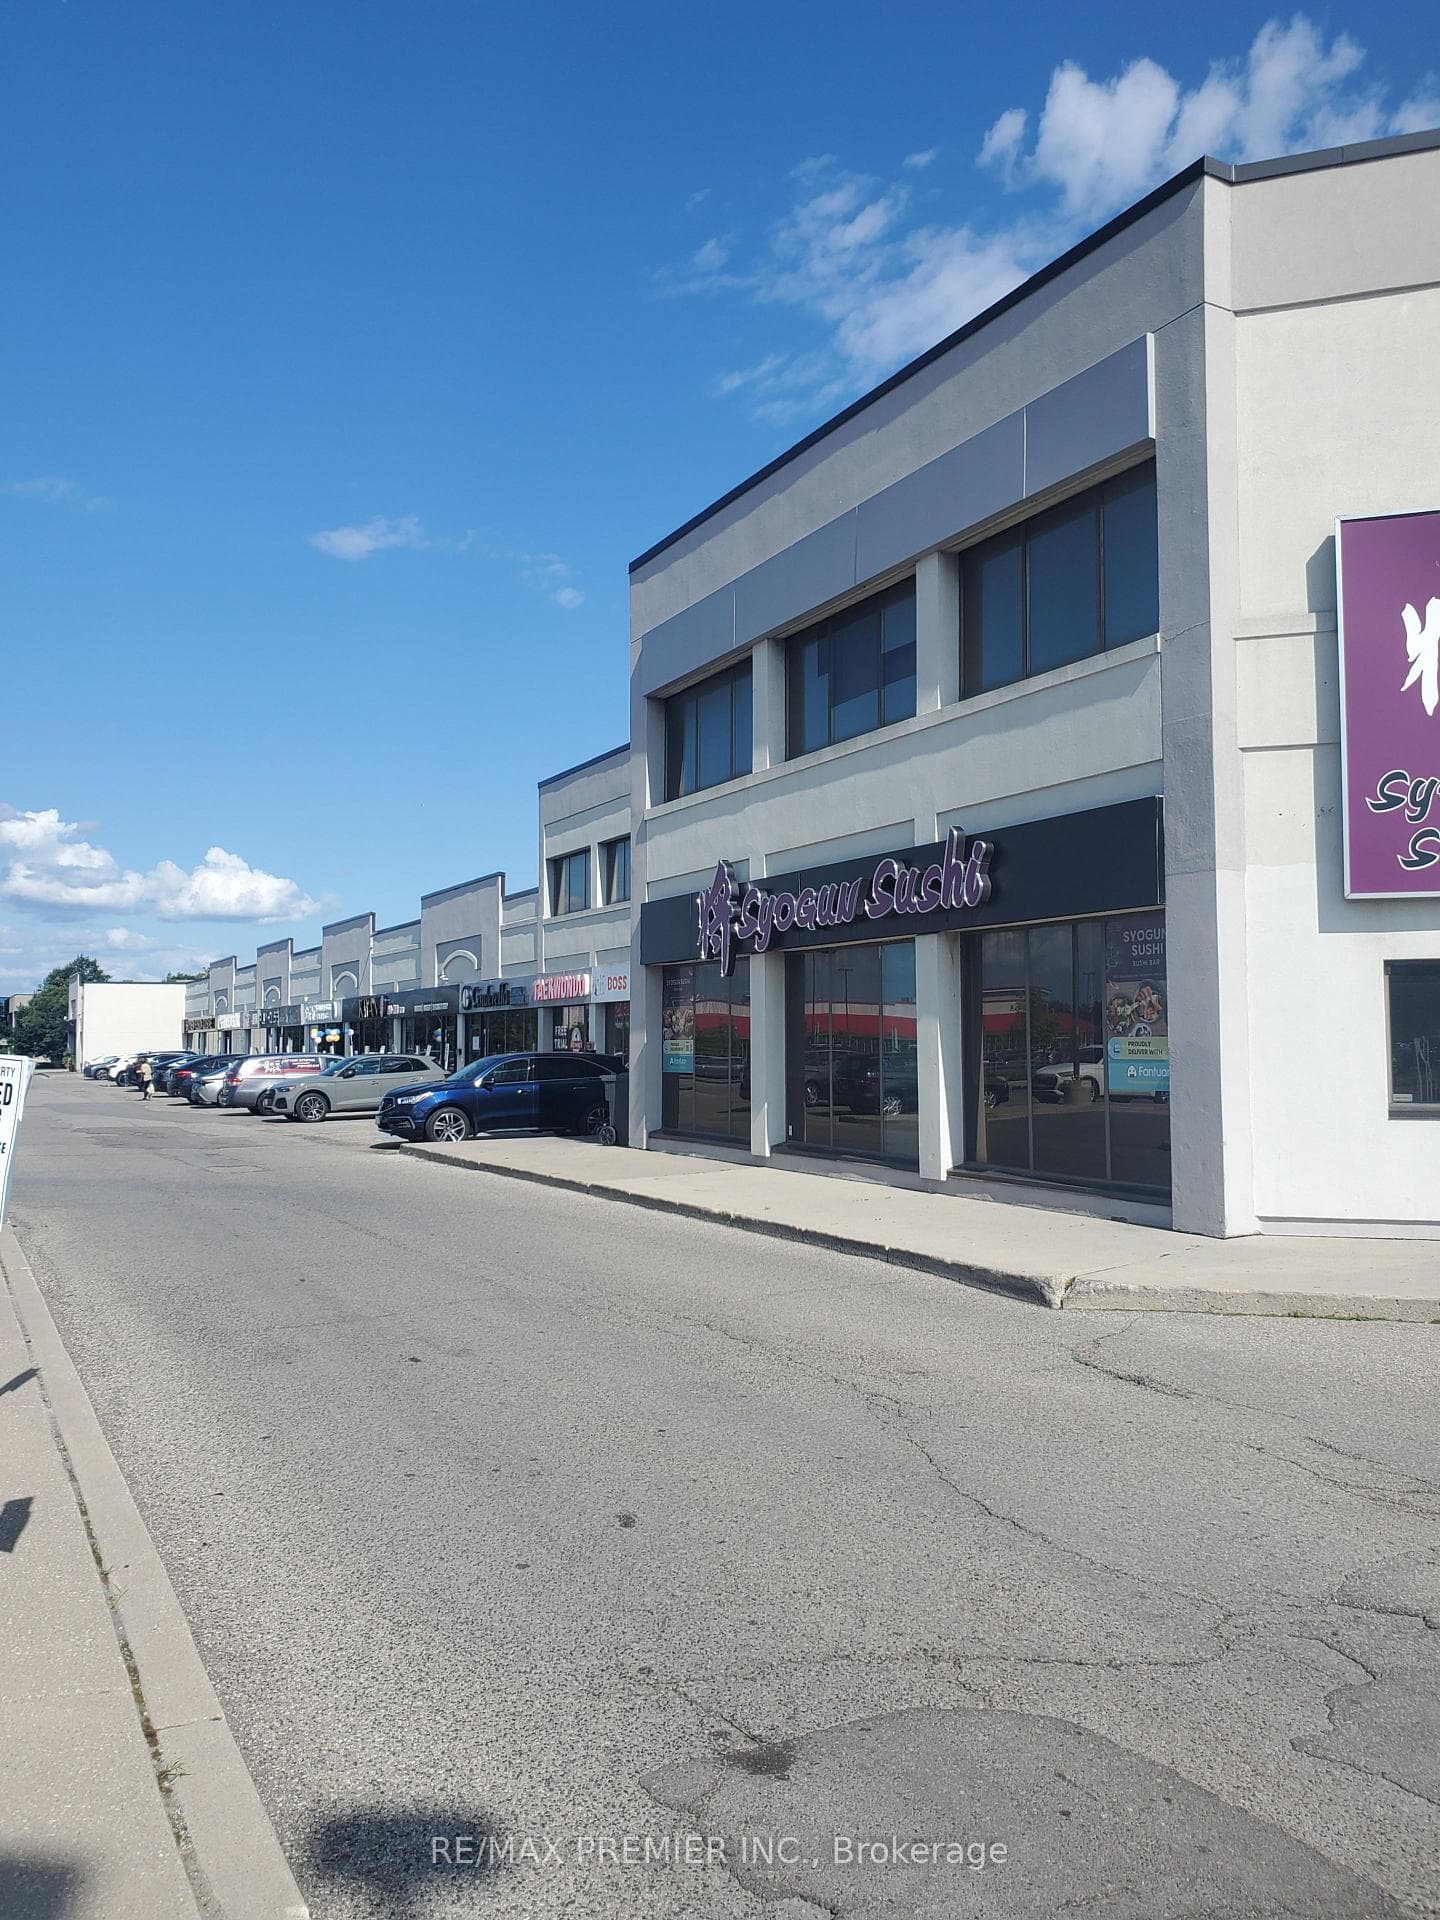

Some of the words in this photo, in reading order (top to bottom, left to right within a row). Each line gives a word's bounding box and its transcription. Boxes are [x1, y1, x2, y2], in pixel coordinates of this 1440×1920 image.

[1365, 769, 1440, 824] Sy
[864, 825, 994, 918] Sushi
[1131, 942, 1163, 956] SUSHI
[533, 974, 590, 1001] TAEKWONDO
[607, 975, 628, 991] BOSS
[555, 1025, 568, 1036] FREE
[554, 1038, 568, 1049] TRIAL
